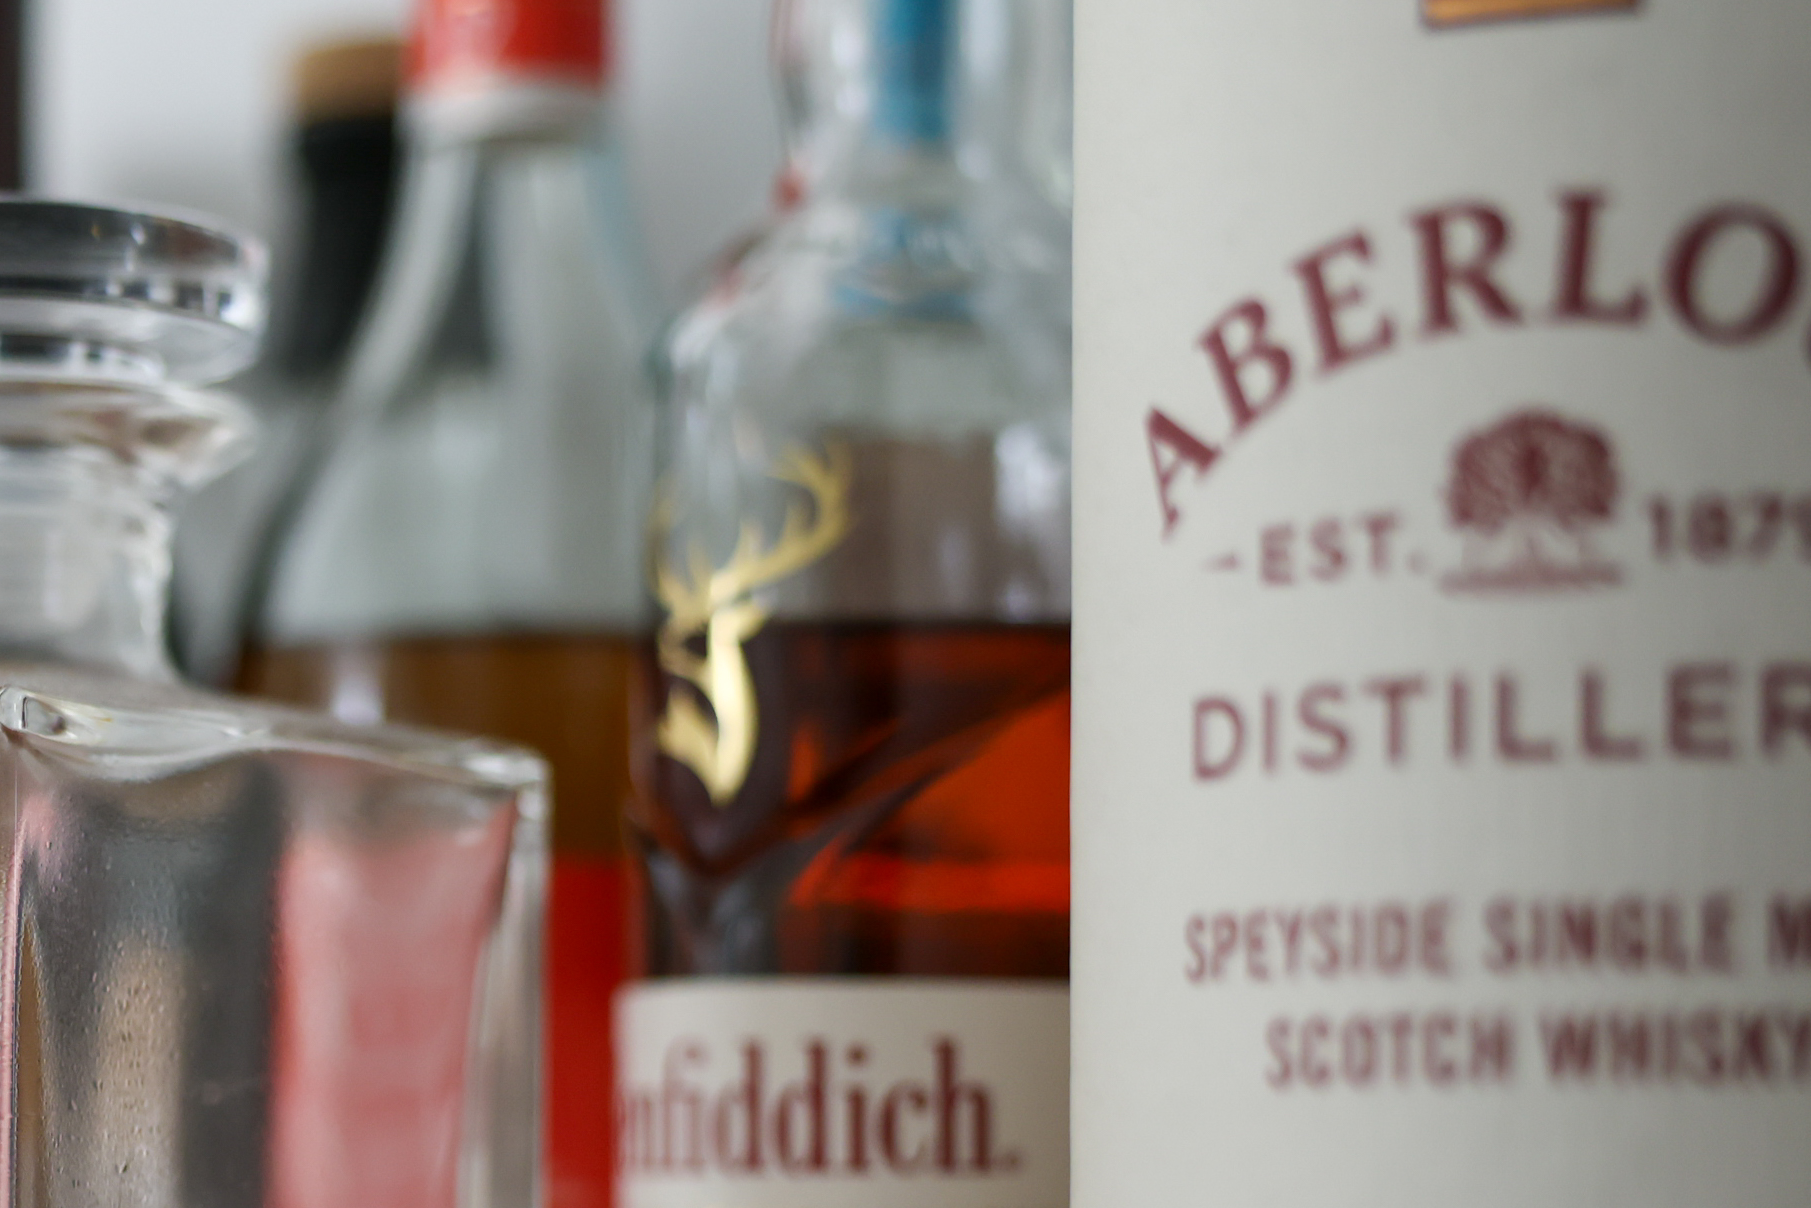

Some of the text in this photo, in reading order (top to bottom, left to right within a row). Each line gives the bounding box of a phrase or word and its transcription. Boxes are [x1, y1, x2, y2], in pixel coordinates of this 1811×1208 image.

[1144, 186, 1811, 542] ABERLO
[1186, 898, 1455, 985] SPEYSIDE
[1484, 890, 1734, 980] SINGLE
[1263, 1006, 1516, 1092] SCOTCH
